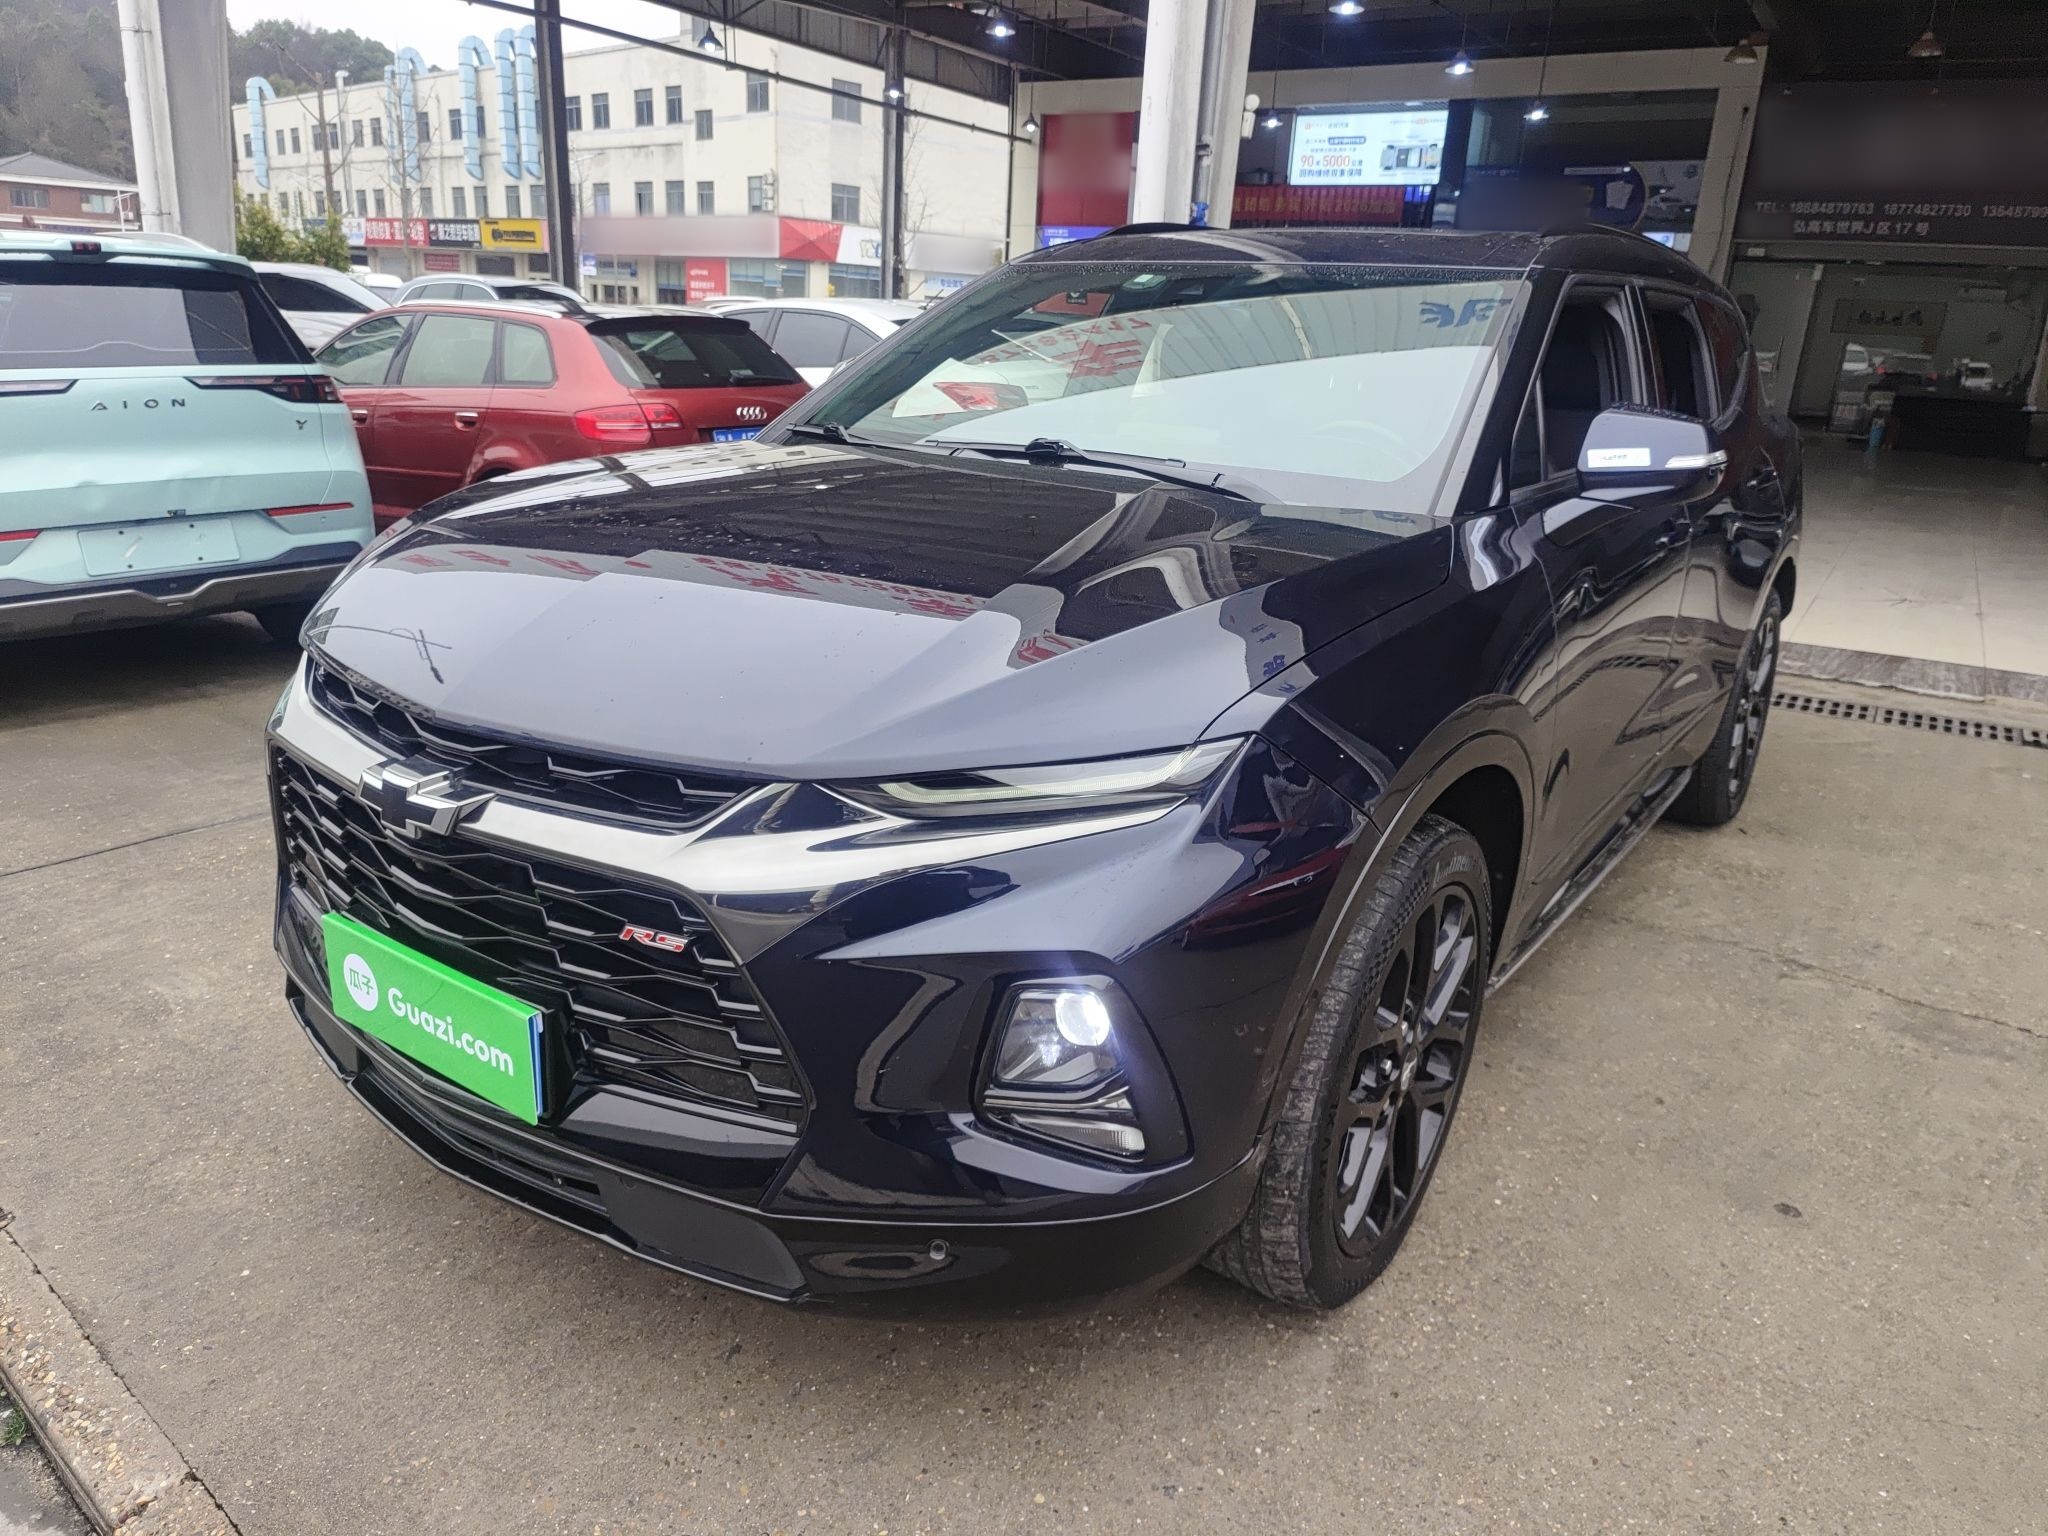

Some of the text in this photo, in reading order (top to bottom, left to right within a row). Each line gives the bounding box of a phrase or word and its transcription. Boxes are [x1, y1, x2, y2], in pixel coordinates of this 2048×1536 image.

[91, 398, 186, 411] AION
[296, 419, 308, 431] Y
[618, 924, 689, 953] RS
[349, 967, 374, 996] 瓜子
[387, 987, 515, 1077] Guazi.com
